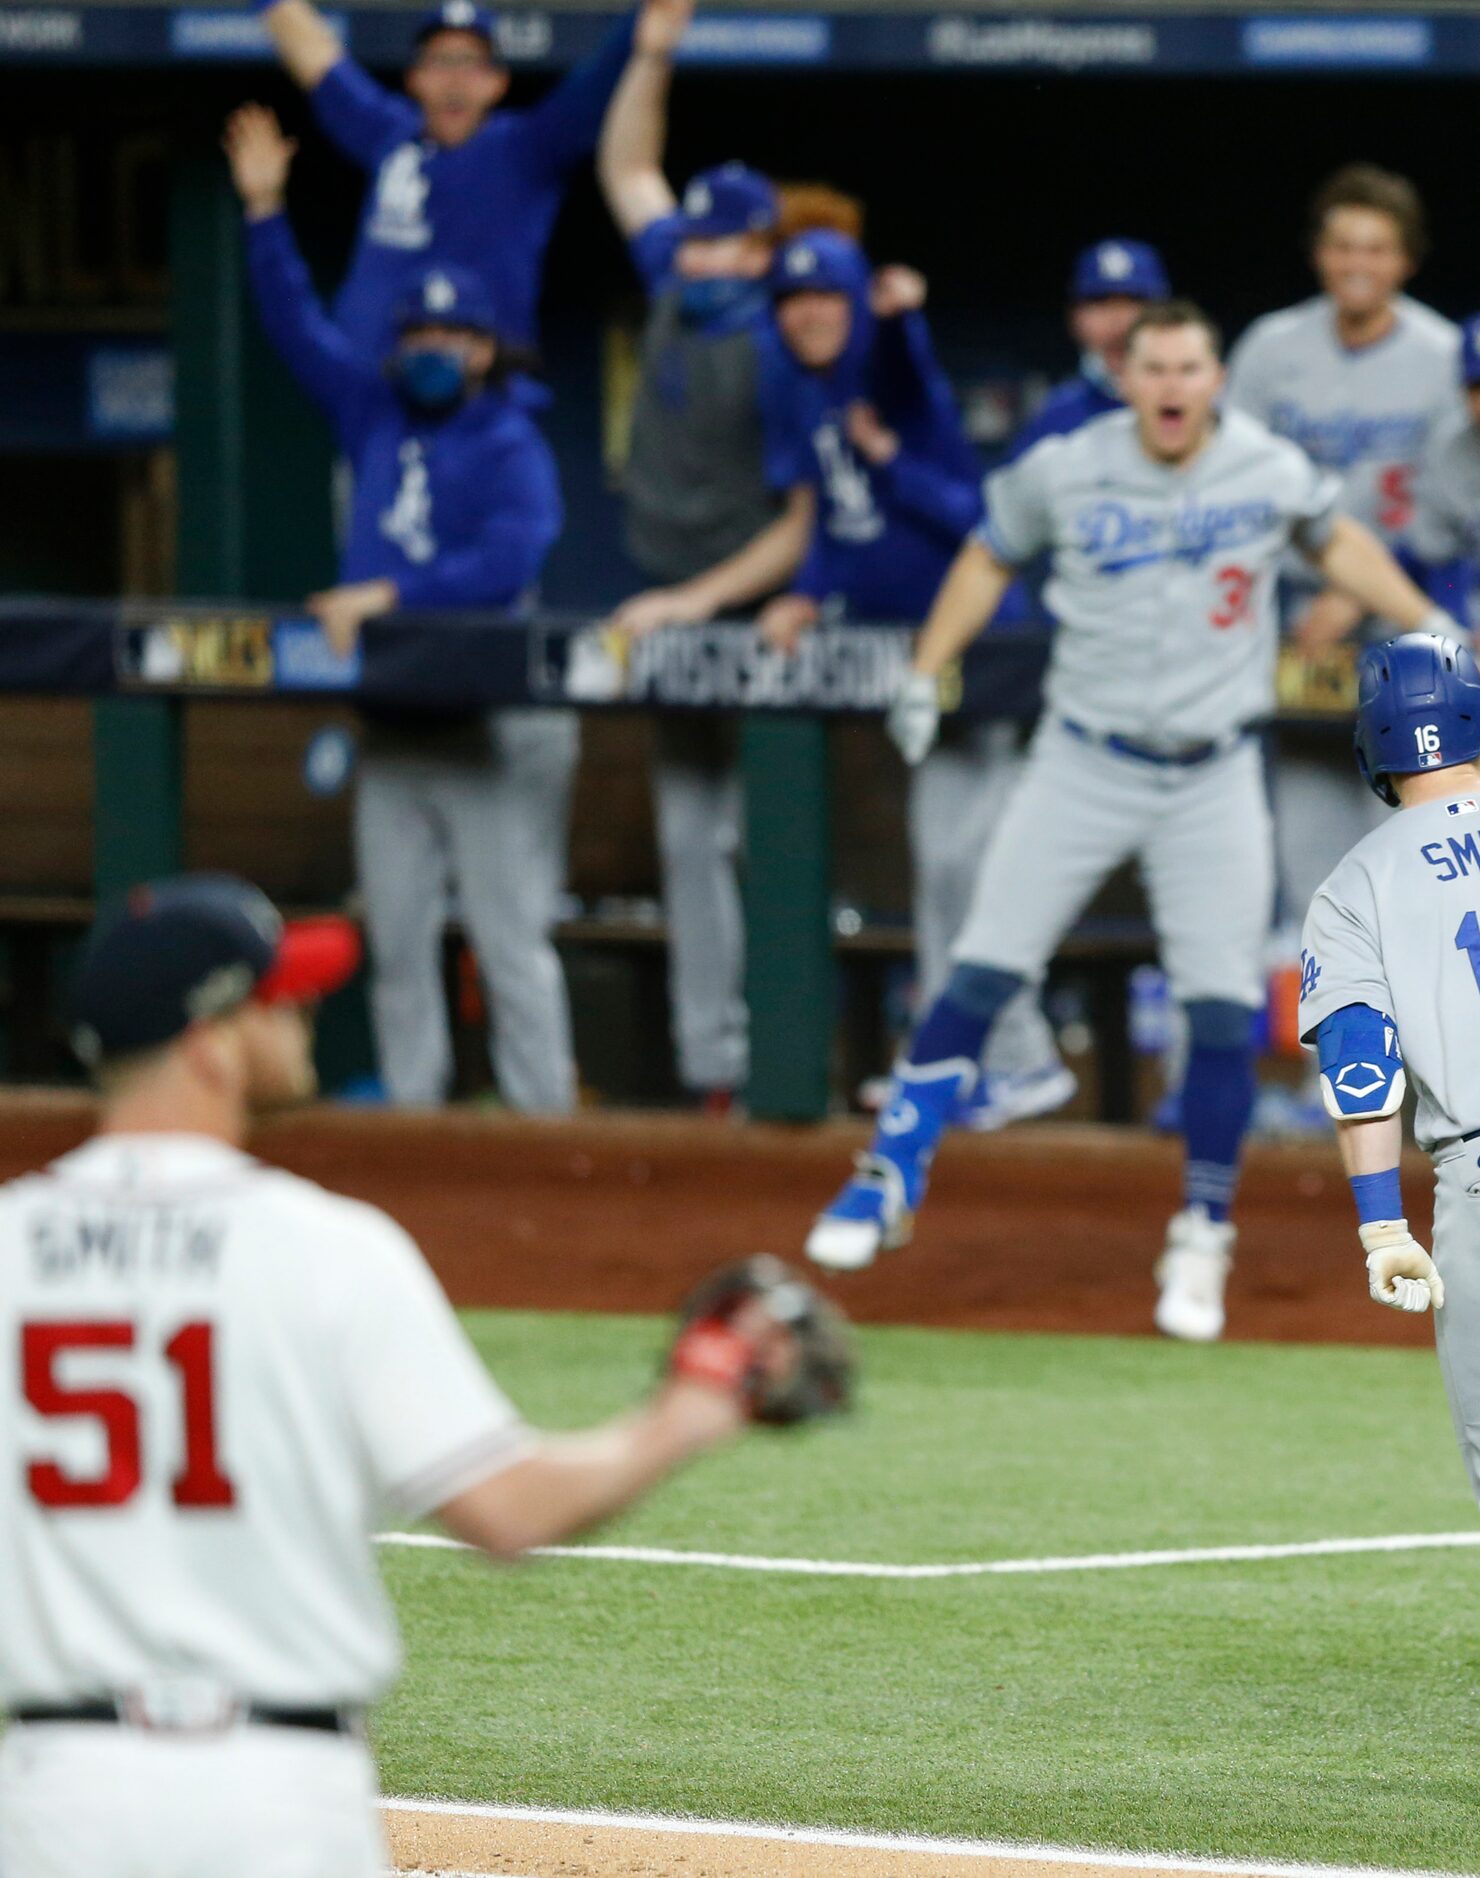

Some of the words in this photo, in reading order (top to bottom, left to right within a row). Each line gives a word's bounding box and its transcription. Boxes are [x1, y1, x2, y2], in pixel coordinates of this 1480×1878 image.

[1414, 724, 1441, 754] 16
[27, 1212, 226, 1286] SMITH
[21, 1320, 236, 1510] 51
